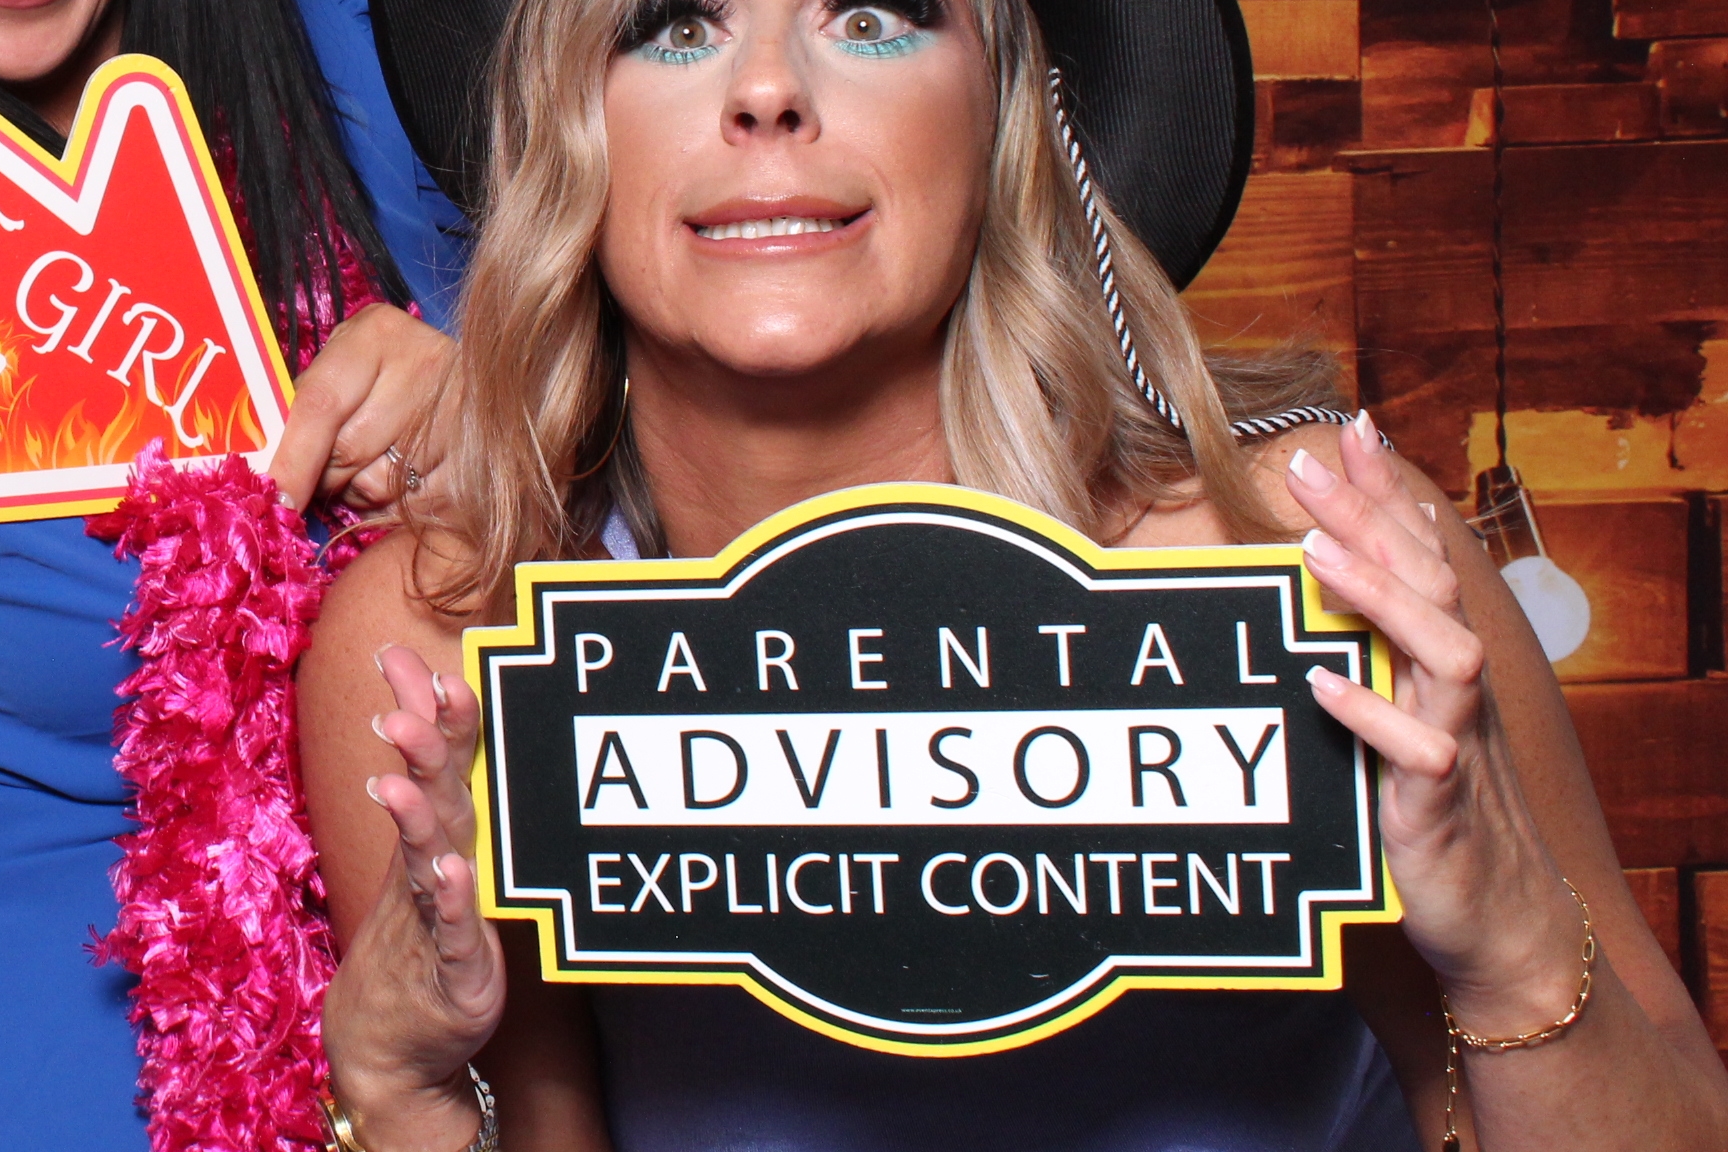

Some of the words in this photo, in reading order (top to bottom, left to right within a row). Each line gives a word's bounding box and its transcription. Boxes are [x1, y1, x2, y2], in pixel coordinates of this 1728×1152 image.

[15, 250, 227, 448] GIRL
[575, 622, 1278, 693] PARENTAL
[584, 724, 1281, 811] ADVISORY
[587, 853, 899, 915] EXPLICIT
[920, 852, 1291, 916] CONTENT
